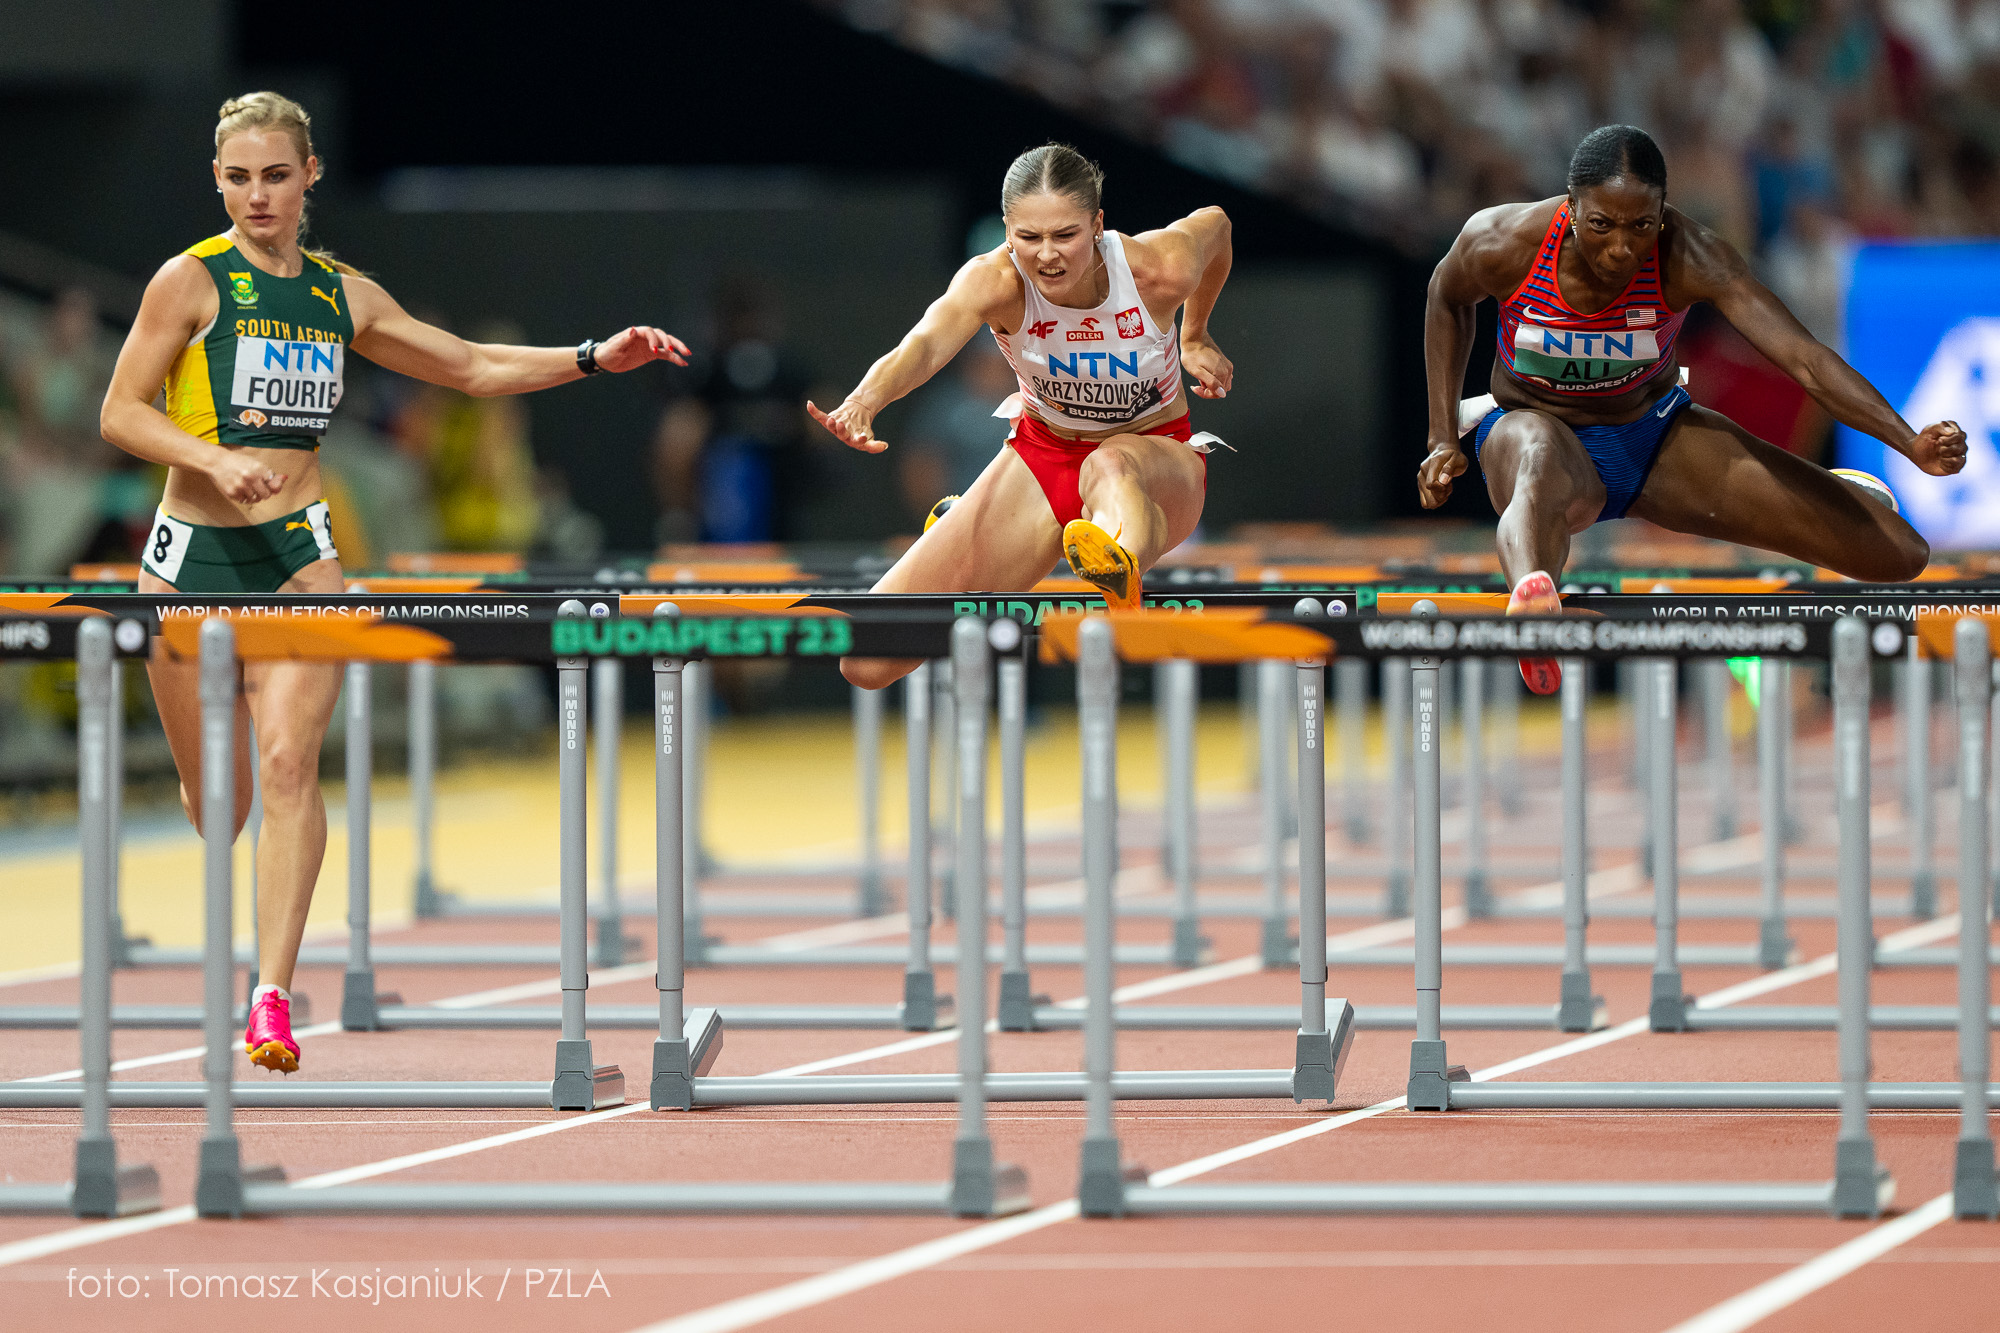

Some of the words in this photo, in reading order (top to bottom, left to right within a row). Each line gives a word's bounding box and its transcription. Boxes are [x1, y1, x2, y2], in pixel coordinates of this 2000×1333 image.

[236, 319, 291, 340] SOUTH
[1068, 332, 1101, 340] ORLEN
[1543, 329, 1633, 359] NTN
[264, 341, 334, 374] NTN
[1048, 351, 1138, 380] NTN
[1560, 361, 1610, 380] ALI
[248, 376, 337, 409] FOURIE
[1556, 375, 1629, 391] BUDAPEST
[271, 416, 330, 429] BUDAPEST
[153, 524, 173, 563] 8
[239, 605, 350, 618] ATHLETICS
[355, 604, 530, 619] CHAMPIONSHIPS
[553, 618, 791, 656] BUDAPEST
[796, 618, 852, 656] 23
[1360, 620, 1456, 650] WORLD
[1458, 620, 1593, 650] ATHLETICS
[1595, 620, 1807, 651] CHAMPIONSHIPS
[565, 700, 578, 750] MONDO
[661, 704, 674, 754] MONDO
[1303, 700, 1317, 749] MONDO
[1419, 702, 1432, 752] MONDO
